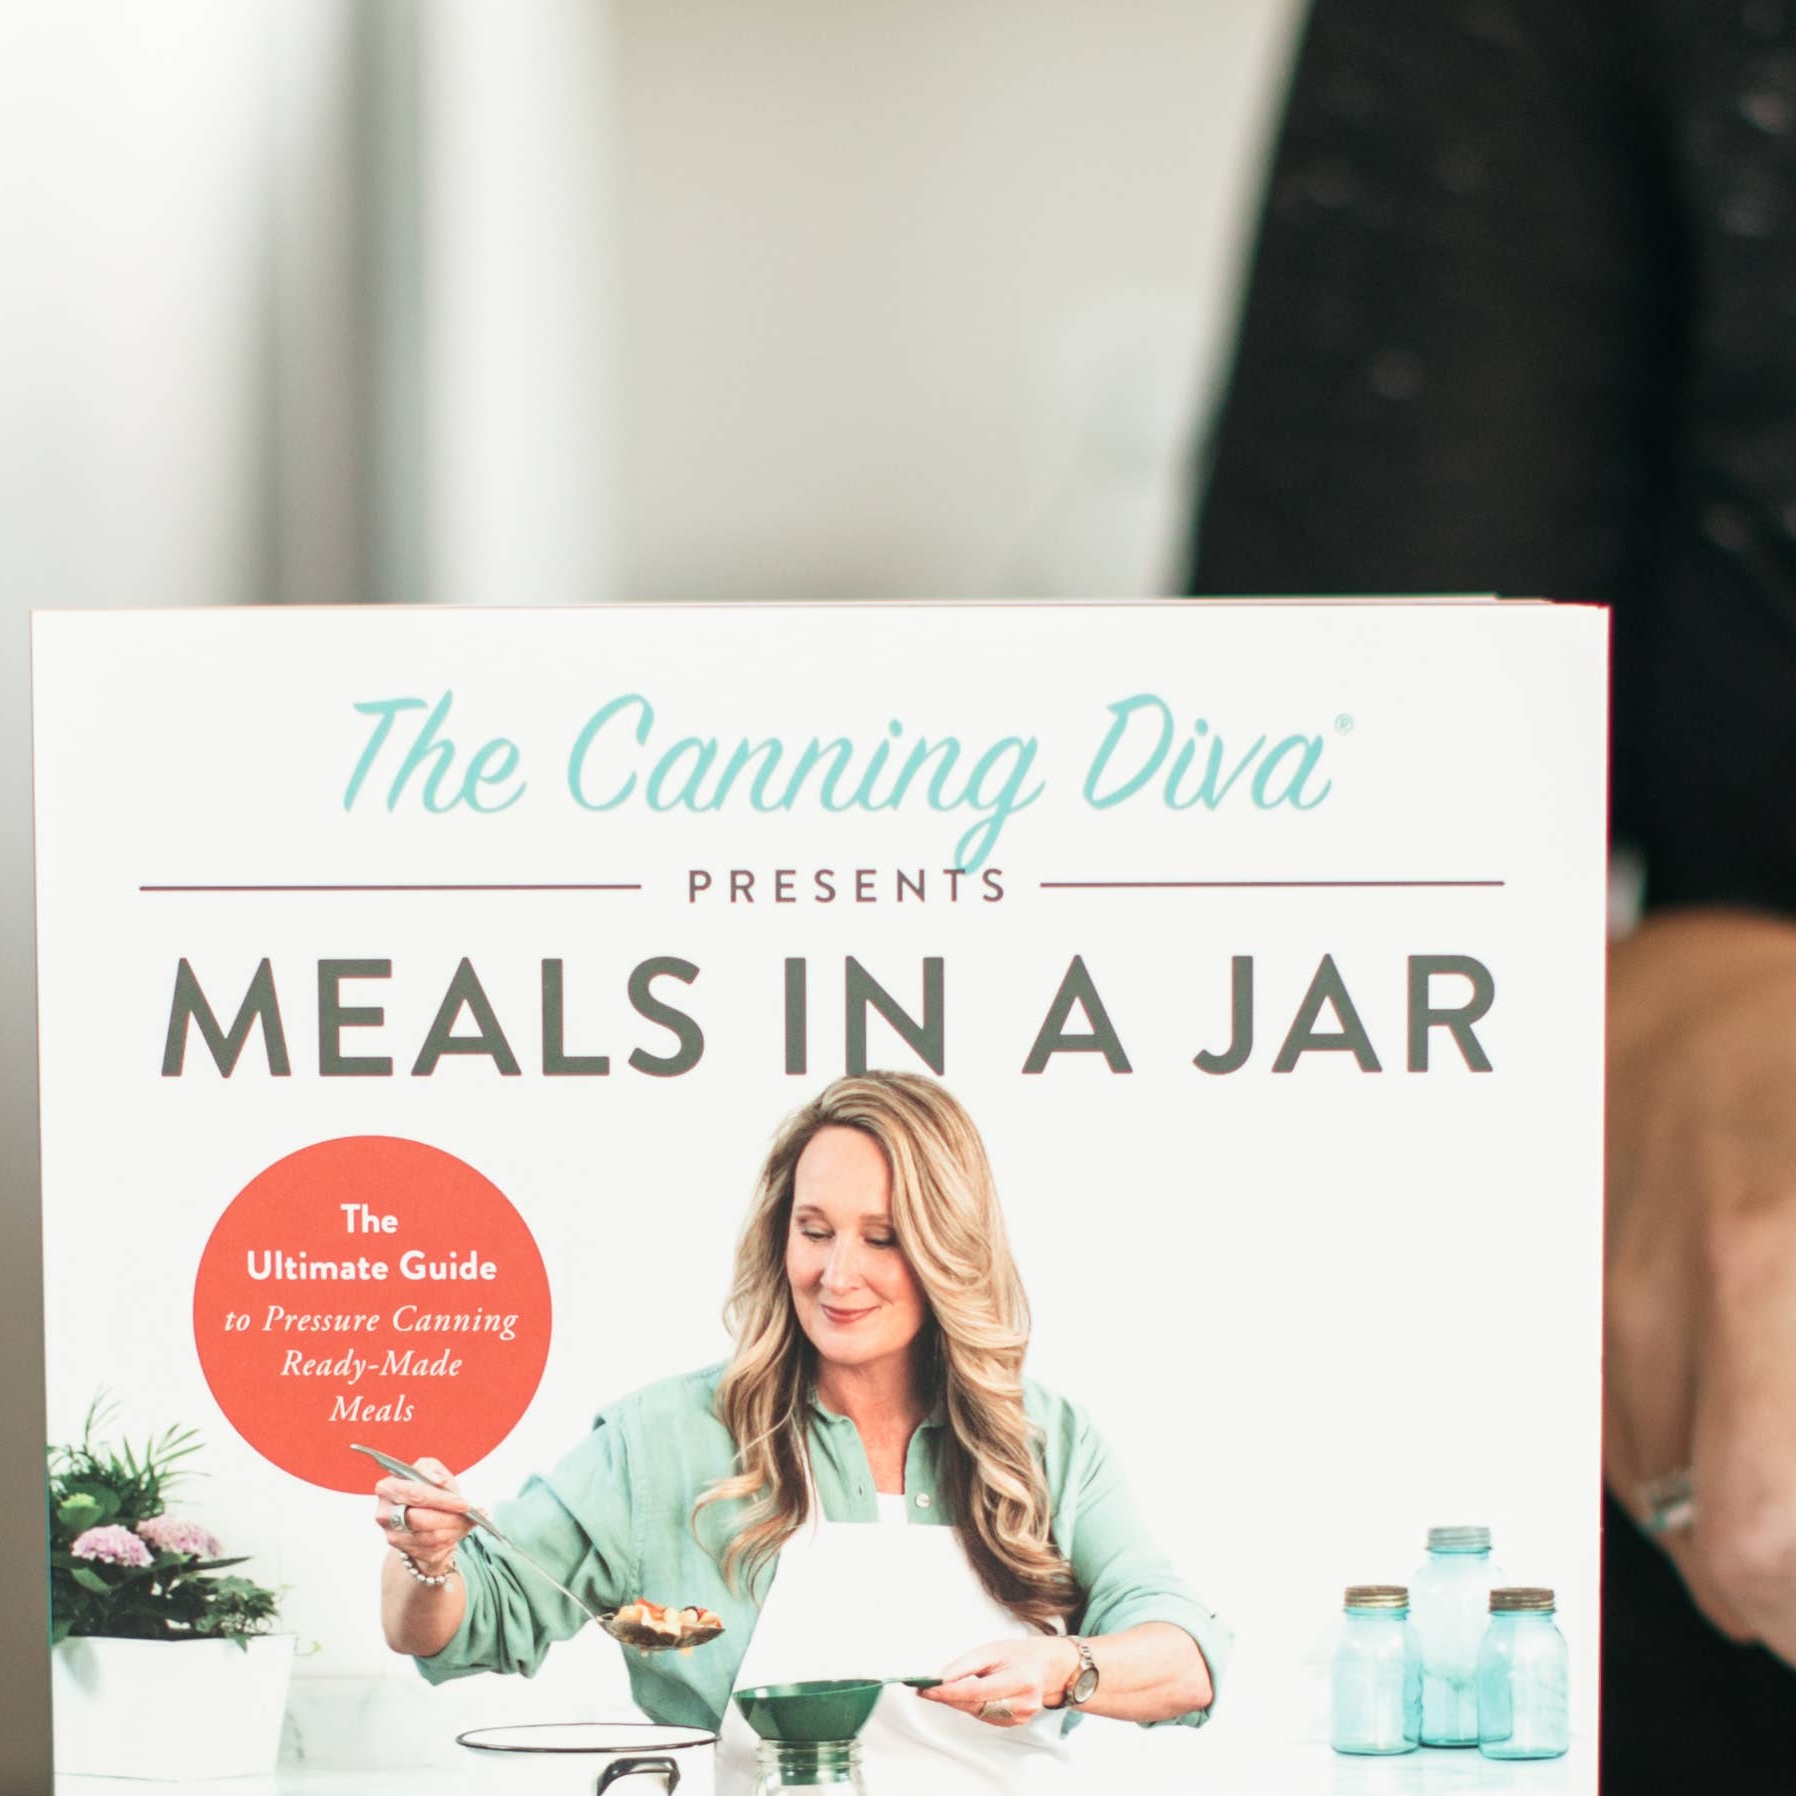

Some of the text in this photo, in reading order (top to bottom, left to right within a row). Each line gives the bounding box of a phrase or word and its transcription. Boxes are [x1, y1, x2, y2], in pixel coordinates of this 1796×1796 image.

[341, 688, 529, 815] The
[565, 691, 1049, 872] Canning
[687, 868, 1008, 906] PRESENTS
[159, 951, 1499, 1082] MEALS IN A JAR
[339, 1202, 399, 1234] The
[246, 1249, 498, 1281] Ultimate Guide
[222, 1304, 519, 1341] to Pressure Canning
[280, 1348, 463, 1385] Ready-Made
[328, 1393, 415, 1423] Meals
